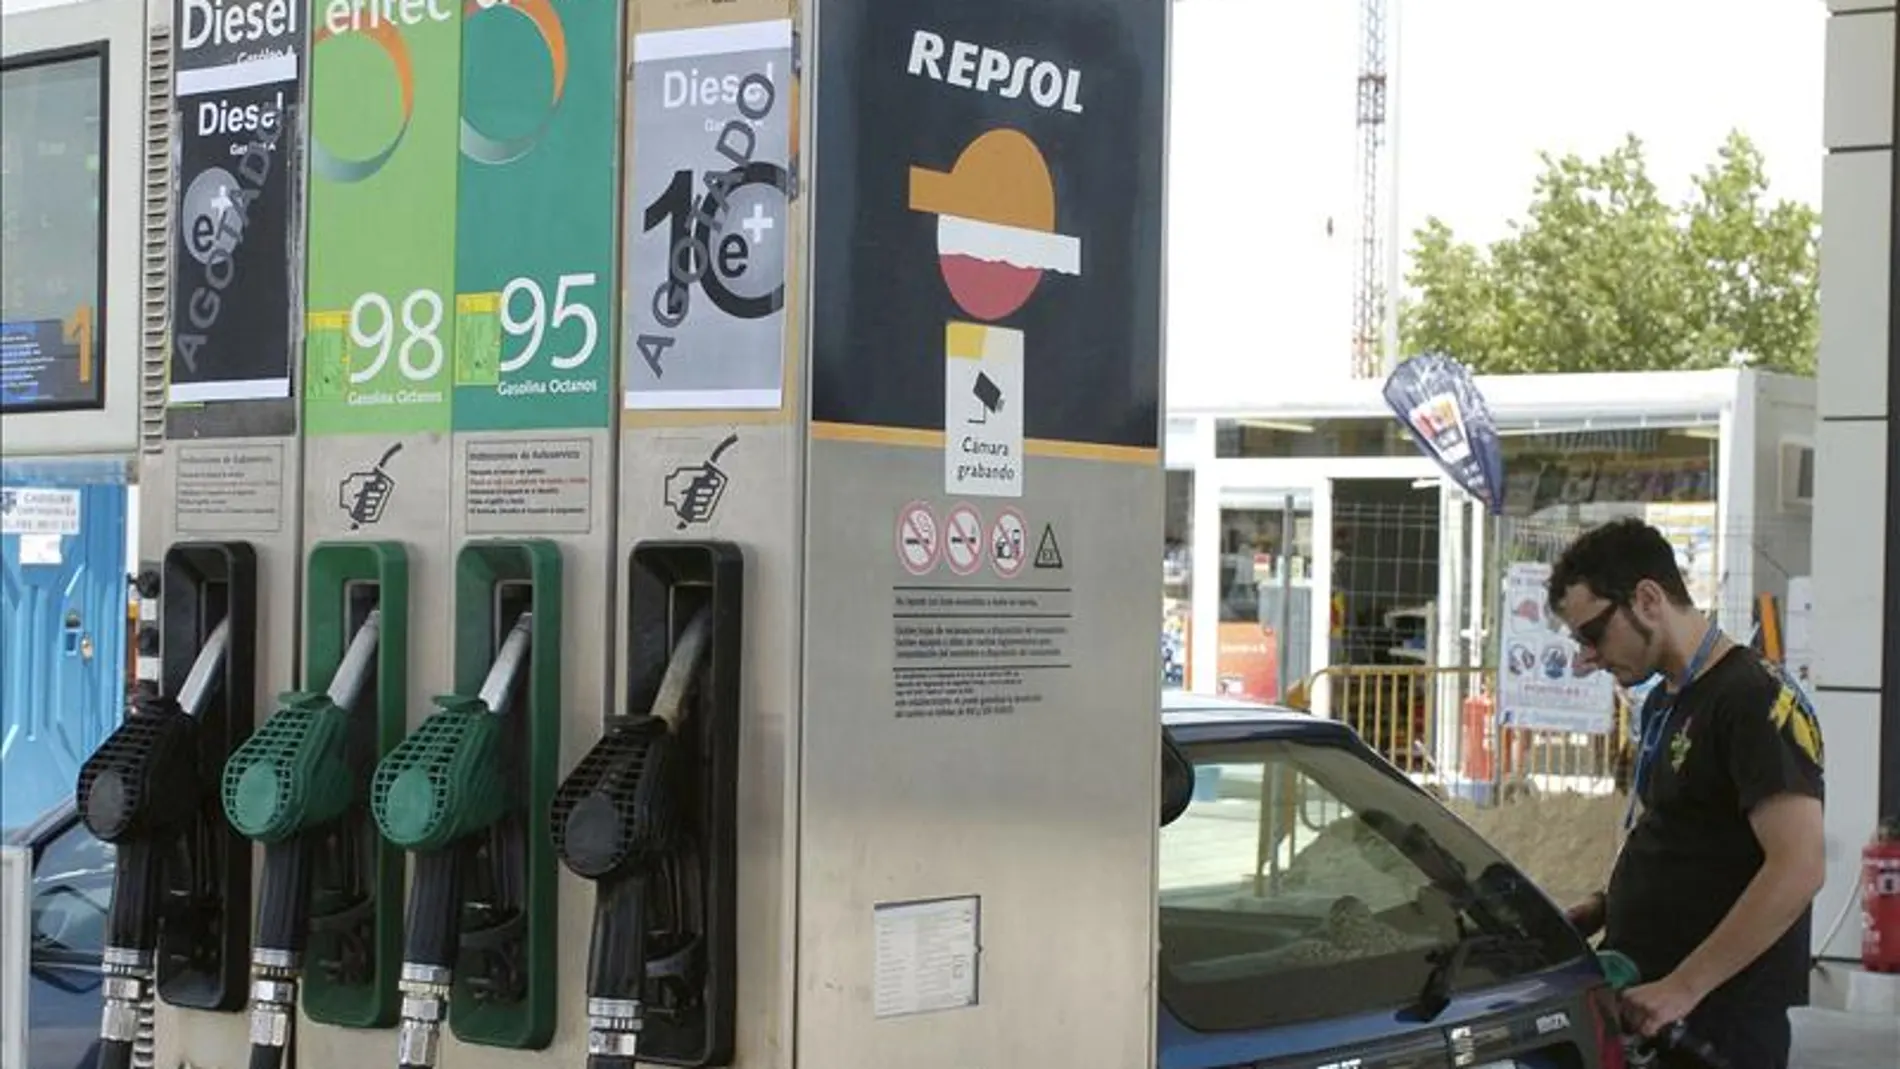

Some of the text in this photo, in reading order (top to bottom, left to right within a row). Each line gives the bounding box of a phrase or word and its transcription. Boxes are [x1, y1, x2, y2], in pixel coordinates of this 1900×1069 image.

[181, 0, 296, 49] Diesel
[907, 29, 1083, 114] REPSOL
[636, 72, 776, 379] AGOTADO
[350, 288, 444, 384] 98
[499, 271, 598, 372] 95
[497, 378, 598, 396] Gasolina Octanos
[956, 463, 1016, 482] grabando
